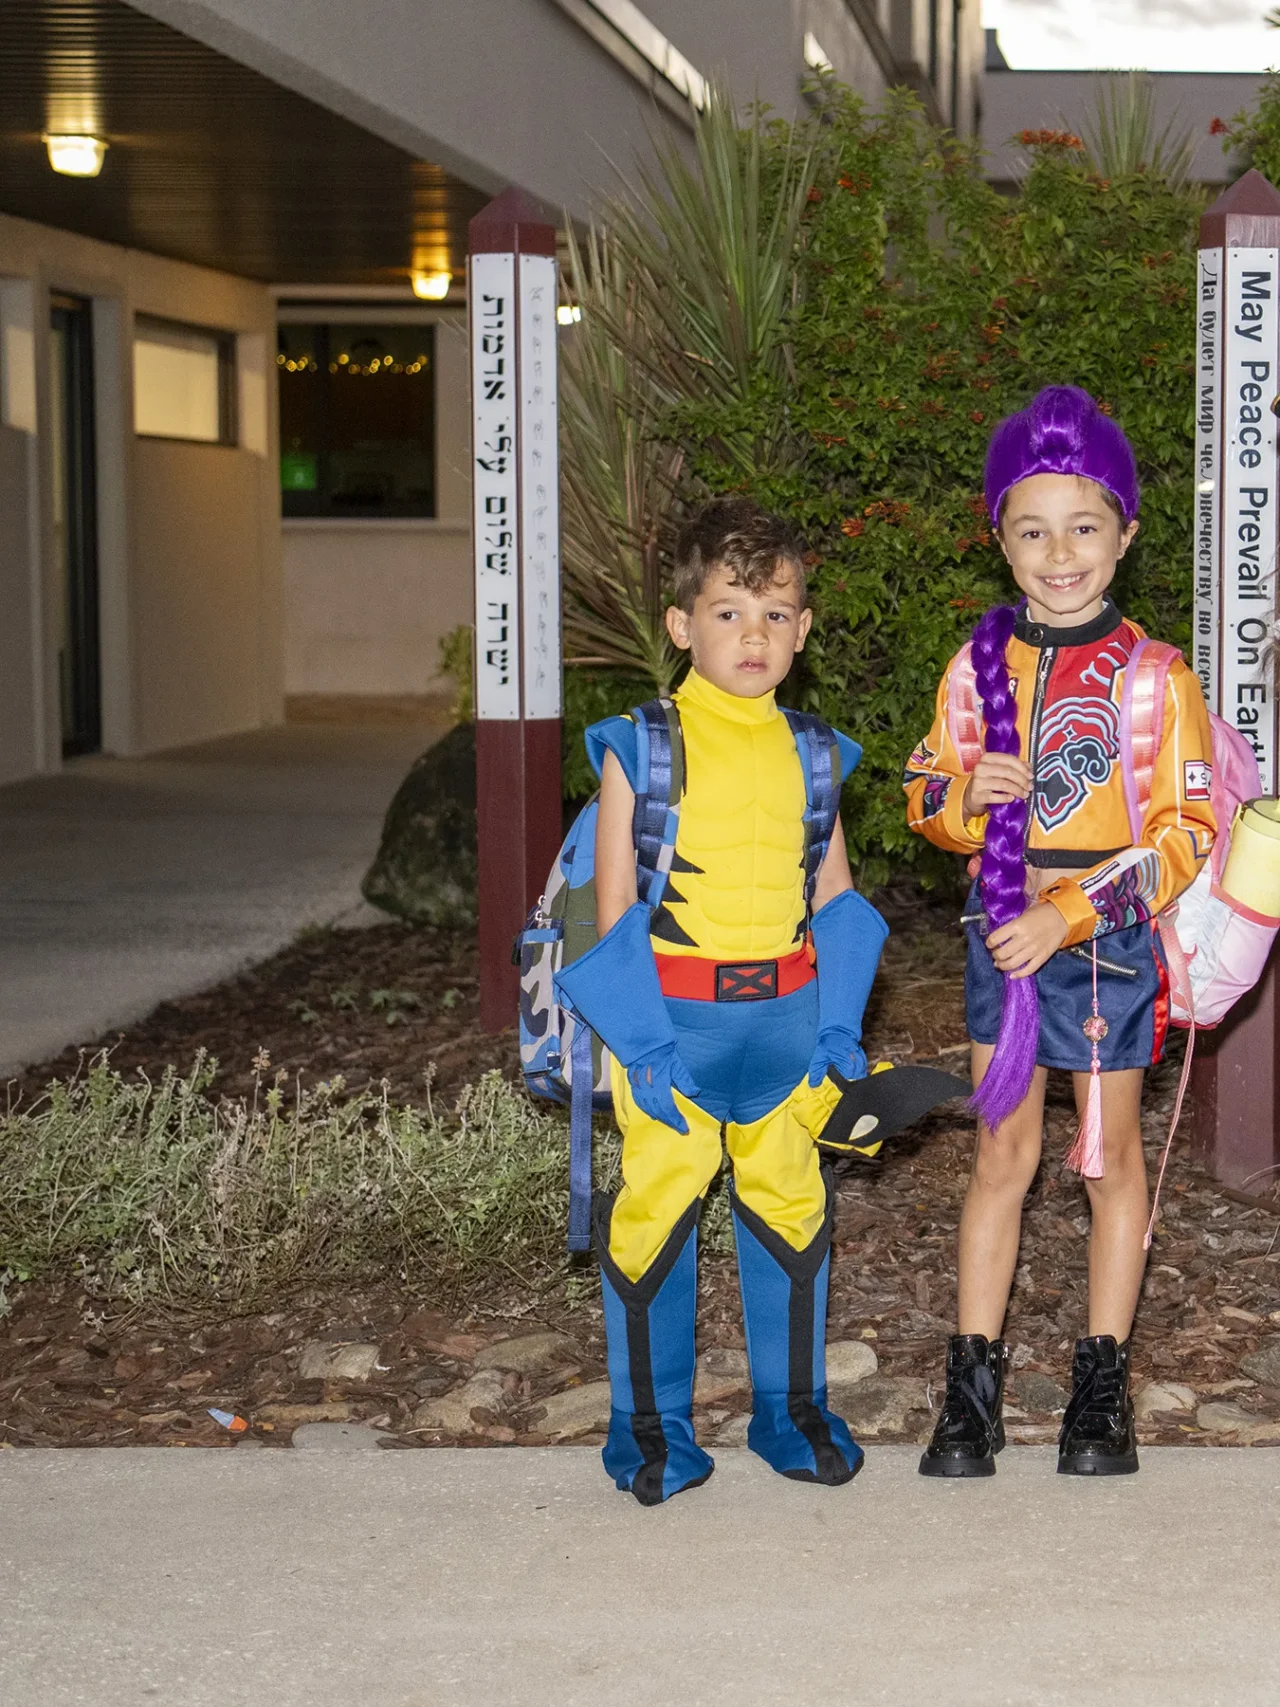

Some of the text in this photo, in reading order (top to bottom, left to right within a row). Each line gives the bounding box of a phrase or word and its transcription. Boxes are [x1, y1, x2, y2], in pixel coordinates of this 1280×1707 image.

[1200, 263, 1218, 301] Да
[1234, 271, 1271, 343] May
[1199, 311, 1217, 376] будет
[1197, 385, 1215, 434] мир
[1238, 361, 1270, 469] Peace
[476, 294, 513, 686] ישרה שלום עלי אדמות
[1237, 487, 1269, 600] Prevail
[1198, 610, 1212, 635] во
[1237, 617, 1268, 665] On
